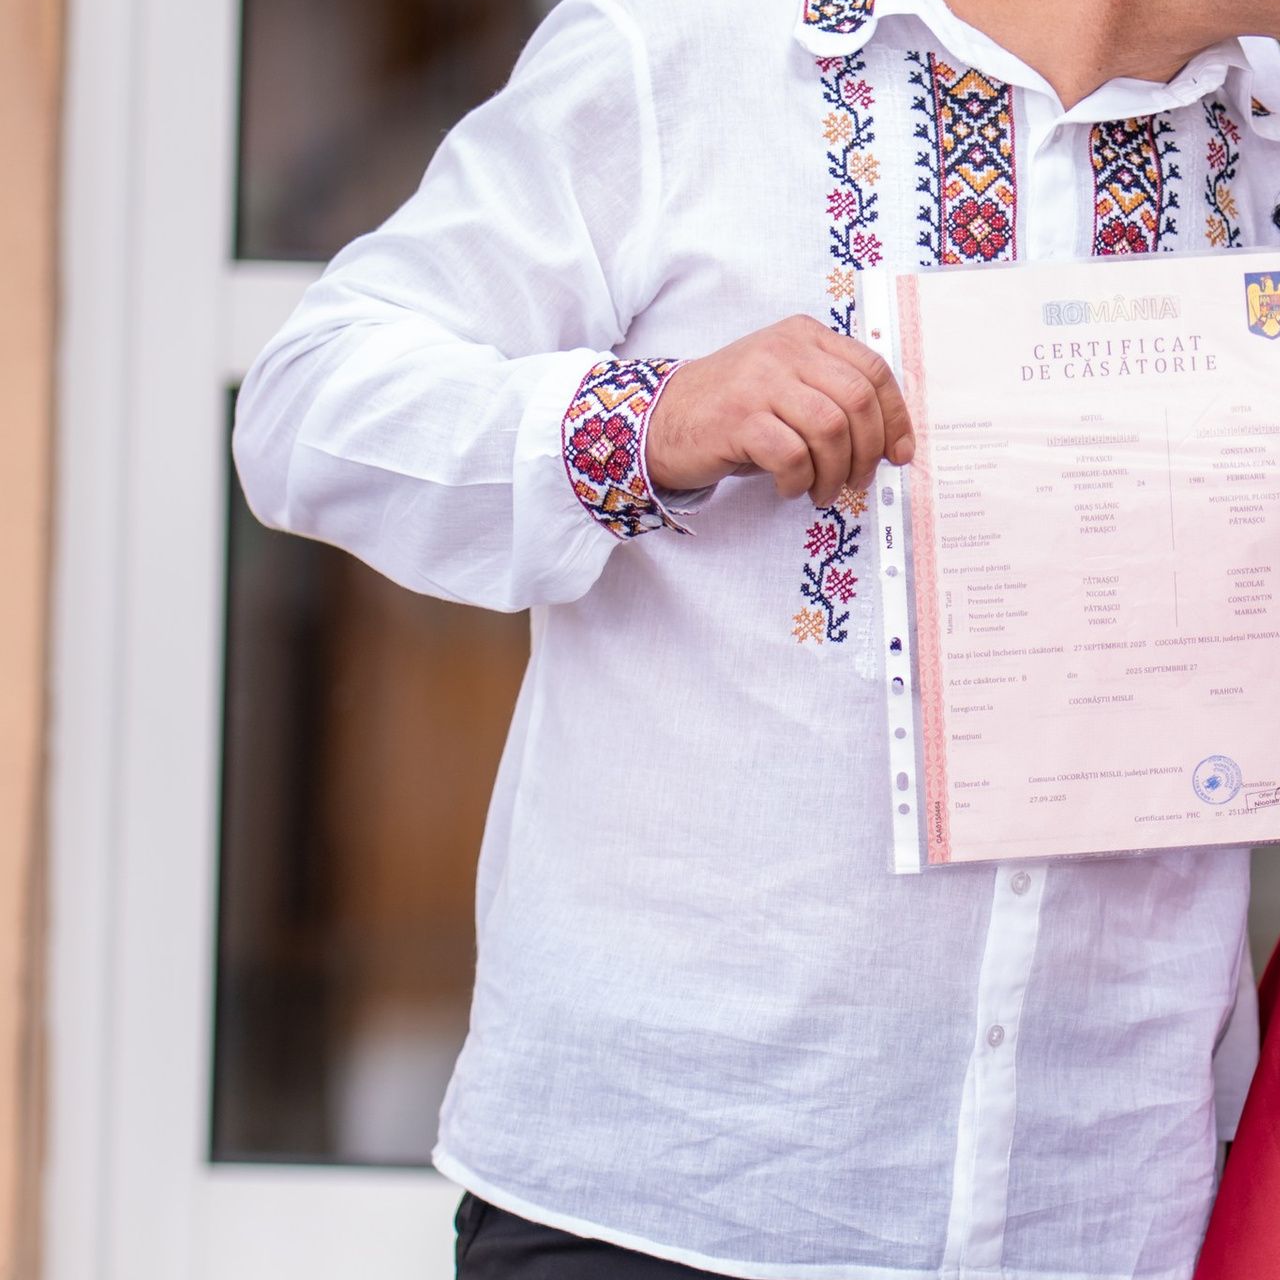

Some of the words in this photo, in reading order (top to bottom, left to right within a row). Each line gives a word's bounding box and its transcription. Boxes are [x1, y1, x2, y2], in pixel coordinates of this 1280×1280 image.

[1045, 295, 1178, 326] ROMÂNIA
[1034, 335, 1201, 360] CERTIFICAT
[1022, 365, 1050, 381] DE
[1064, 355, 1217, 378] CĂSĂTORIE
[951, 421, 976, 430] privind
[979, 441, 1009, 451] personal
[1221, 446, 1266, 455] CONSTANTIN
[937, 464, 964, 472] Numele
[974, 462, 998, 470] familie
[1061, 469, 1130, 479] GHEORGHE-DANIEL
[1189, 476, 1205, 484] 1981
[1226, 473, 1266, 482] FEBRUARIE
[1073, 482, 1114, 491] FEBRUARIE
[939, 492, 955, 500] Data
[1208, 494, 1250, 503] MUNICIPIUL
[1230, 505, 1263, 513] PRAHOVA
[940, 511, 958, 519] Locul
[1080, 514, 1115, 522] PRAHOVA
[978, 532, 1001, 541] familie
[960, 565, 984, 573] privind
[1227, 566, 1272, 575] CONSTANTIN
[1234, 580, 1265, 588] NICOLAE
[1086, 589, 1117, 598] NICOLAE
[967, 597, 1004, 605] Prenumele
[1228, 594, 1272, 603] CONSTANTIN
[968, 612, 994, 620] Numele
[1005, 610, 1028, 618] familie
[1234, 607, 1267, 616] MARIANA
[1088, 617, 1117, 626] VIORICA
[969, 625, 1005, 633] Prenumele
[947, 652, 964, 660] Data
[973, 650, 991, 658] locul
[1083, 641, 1128, 651] SEPTEMBRIE
[1247, 632, 1280, 640] PRAHOVA
[949, 678, 962, 686] Act
[1125, 667, 1143, 675] 2025
[1143, 664, 1189, 674] SEPTEMBRIE
[1112, 694, 1134, 702] MISLII
[1210, 687, 1244, 696] PRAHOVA
[954, 780, 980, 789] Eliberat
[1028, 775, 1056, 784] Comuna
[1149, 766, 1183, 774] PRAHOVA
[1029, 795, 1067, 804] 27.09.2025
[1134, 814, 1165, 823] Certificat
[1165, 813, 1182, 821] seria
[1186, 811, 1201, 819] PHC
